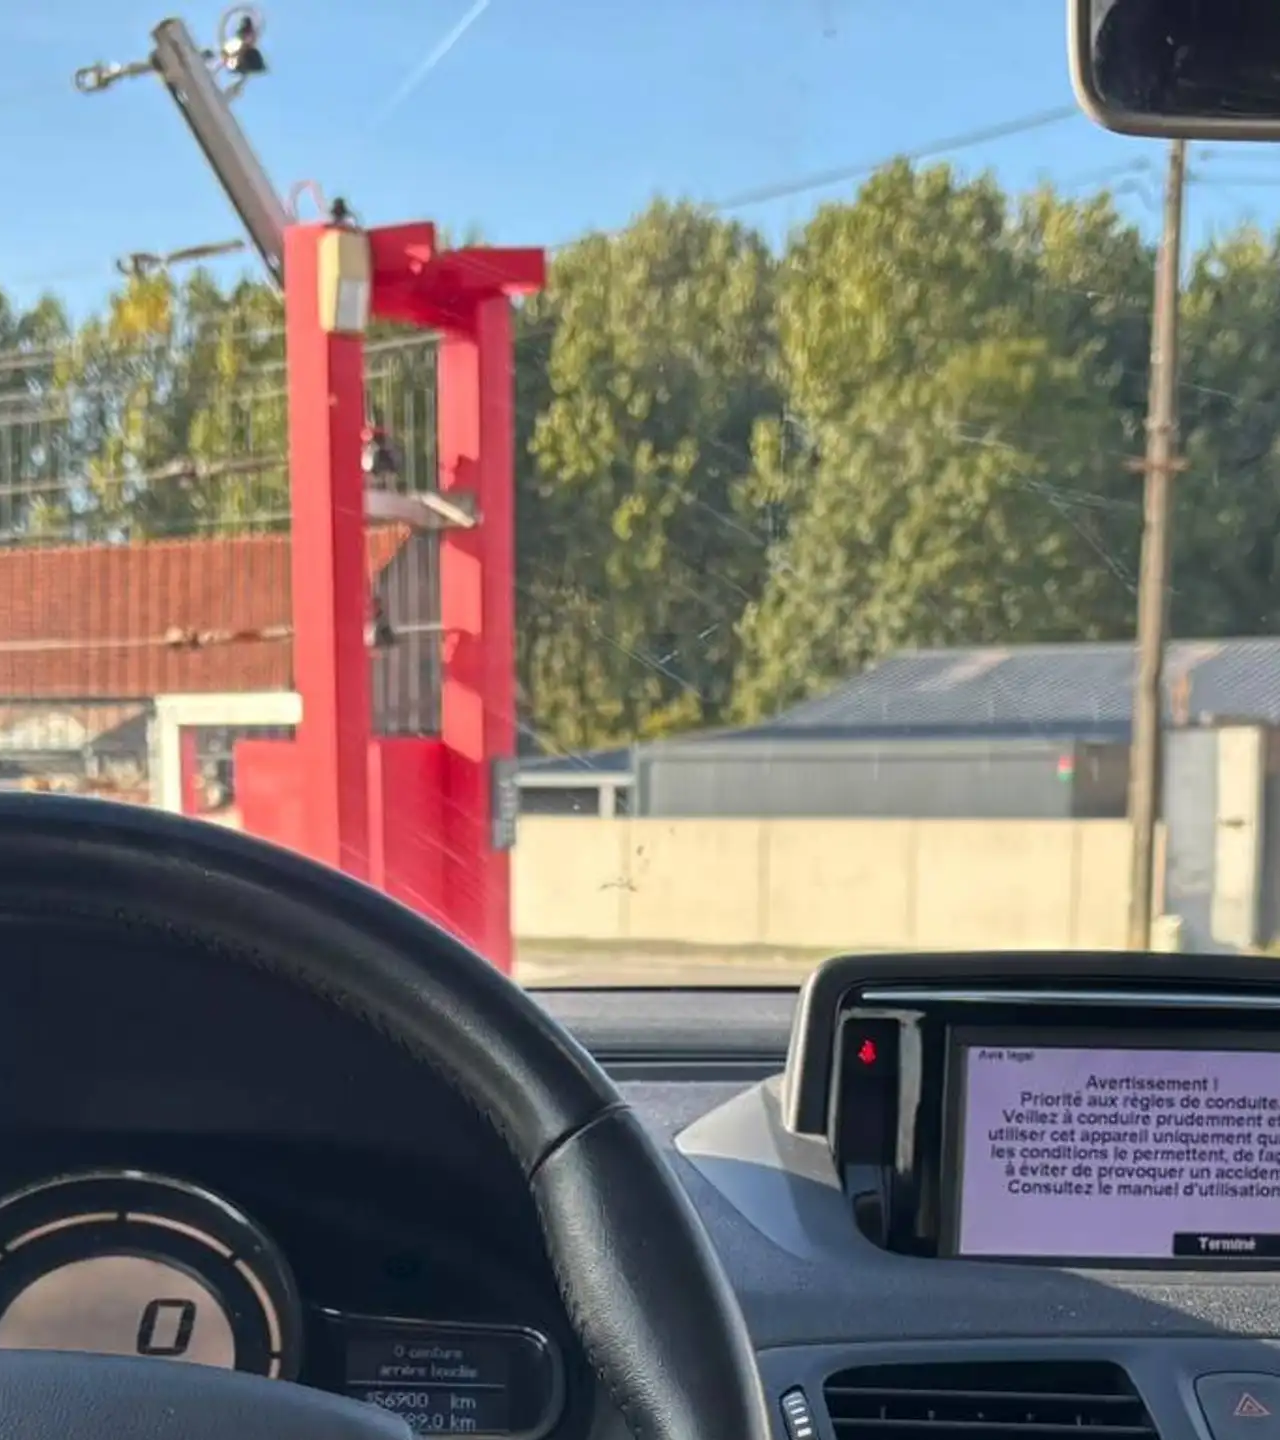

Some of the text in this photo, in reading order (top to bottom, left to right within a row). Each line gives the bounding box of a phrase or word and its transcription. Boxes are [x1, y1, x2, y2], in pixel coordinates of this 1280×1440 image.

[1086, 1074, 1208, 1092] Avertissement
[1020, 1091, 1082, 1107] Priorité
[1086, 1095, 1118, 1107] aux
[1122, 1093, 1175, 1111] règles
[1180, 1095, 1200, 1109] de
[1002, 1109, 1058, 1124] Veillez
[1062, 1109, 1072, 1124] à
[1076, 1111, 1151, 1125] conduire
[1156, 1112, 1262, 1128] prudemment
[988, 1127, 1045, 1141] utiliser
[1050, 1129, 1075, 1142] cet
[1080, 1129, 1148, 1145] appareil
[1153, 1130, 1251, 1148] uniquement
[991, 1144, 1015, 1159] les
[1020, 1145, 1108, 1160] conditions
[1114, 1146, 1127, 1161] le
[1132, 1148, 1228, 1164] permettent,
[1233, 1149, 1254, 1163] de
[1005, 1160, 1015, 1176] à
[1020, 1161, 1067, 1177] éviter
[1072, 1163, 1092, 1177] de
[1098, 1164, 1184, 1181] provoquer
[1190, 1167, 1211, 1180] un
[1008, 1178, 1092, 1195] Consultez
[1098, 1180, 1112, 1195] le
[1117, 1181, 1178, 1196] manuel
[136, 1298, 195, 1356] 0
[450, 1392, 476, 1409] km
[450, 1413, 476, 1432] km
